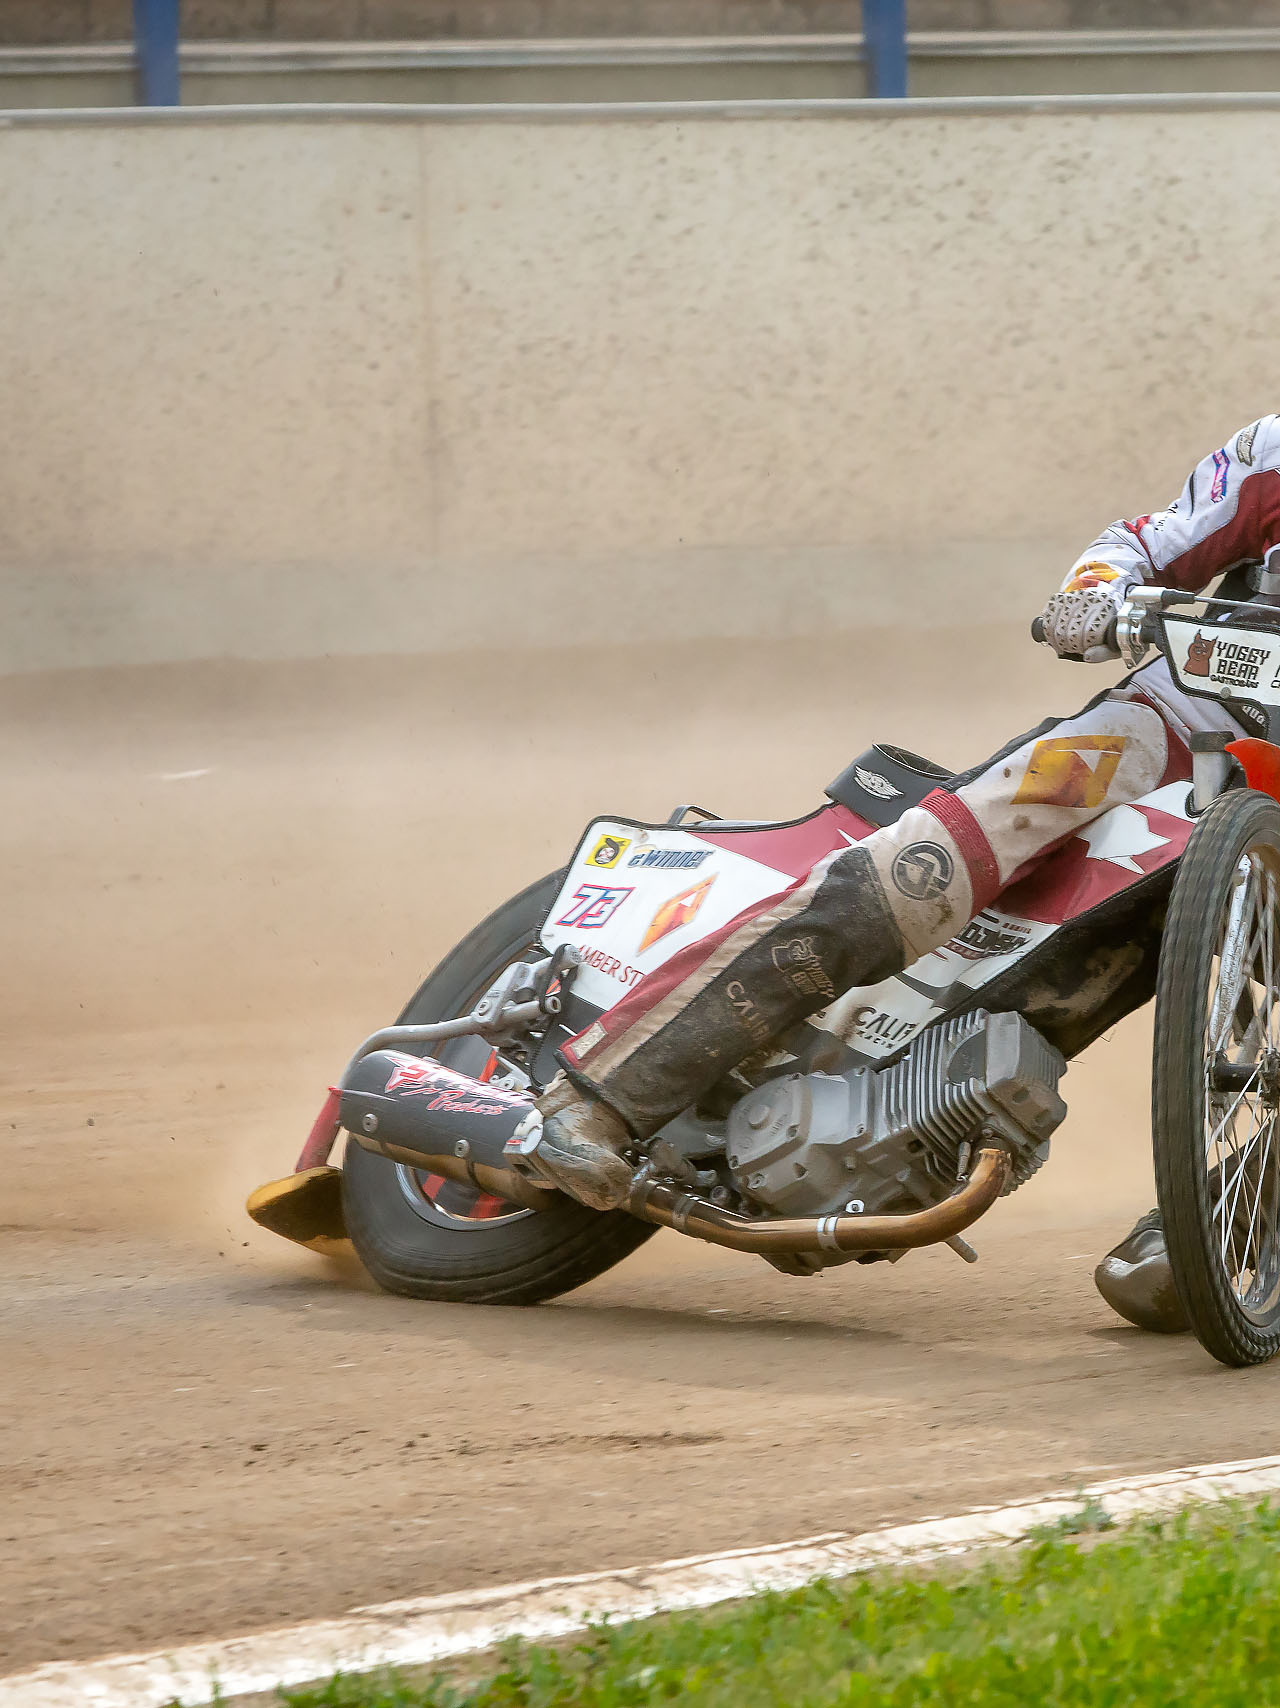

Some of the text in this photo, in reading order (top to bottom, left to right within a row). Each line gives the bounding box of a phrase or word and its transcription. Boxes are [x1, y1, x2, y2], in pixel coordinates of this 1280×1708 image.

[1216, 640, 1271, 665] YOGGY
[1217, 659, 1260, 680] BEAR
[554, 883, 636, 929] 73
